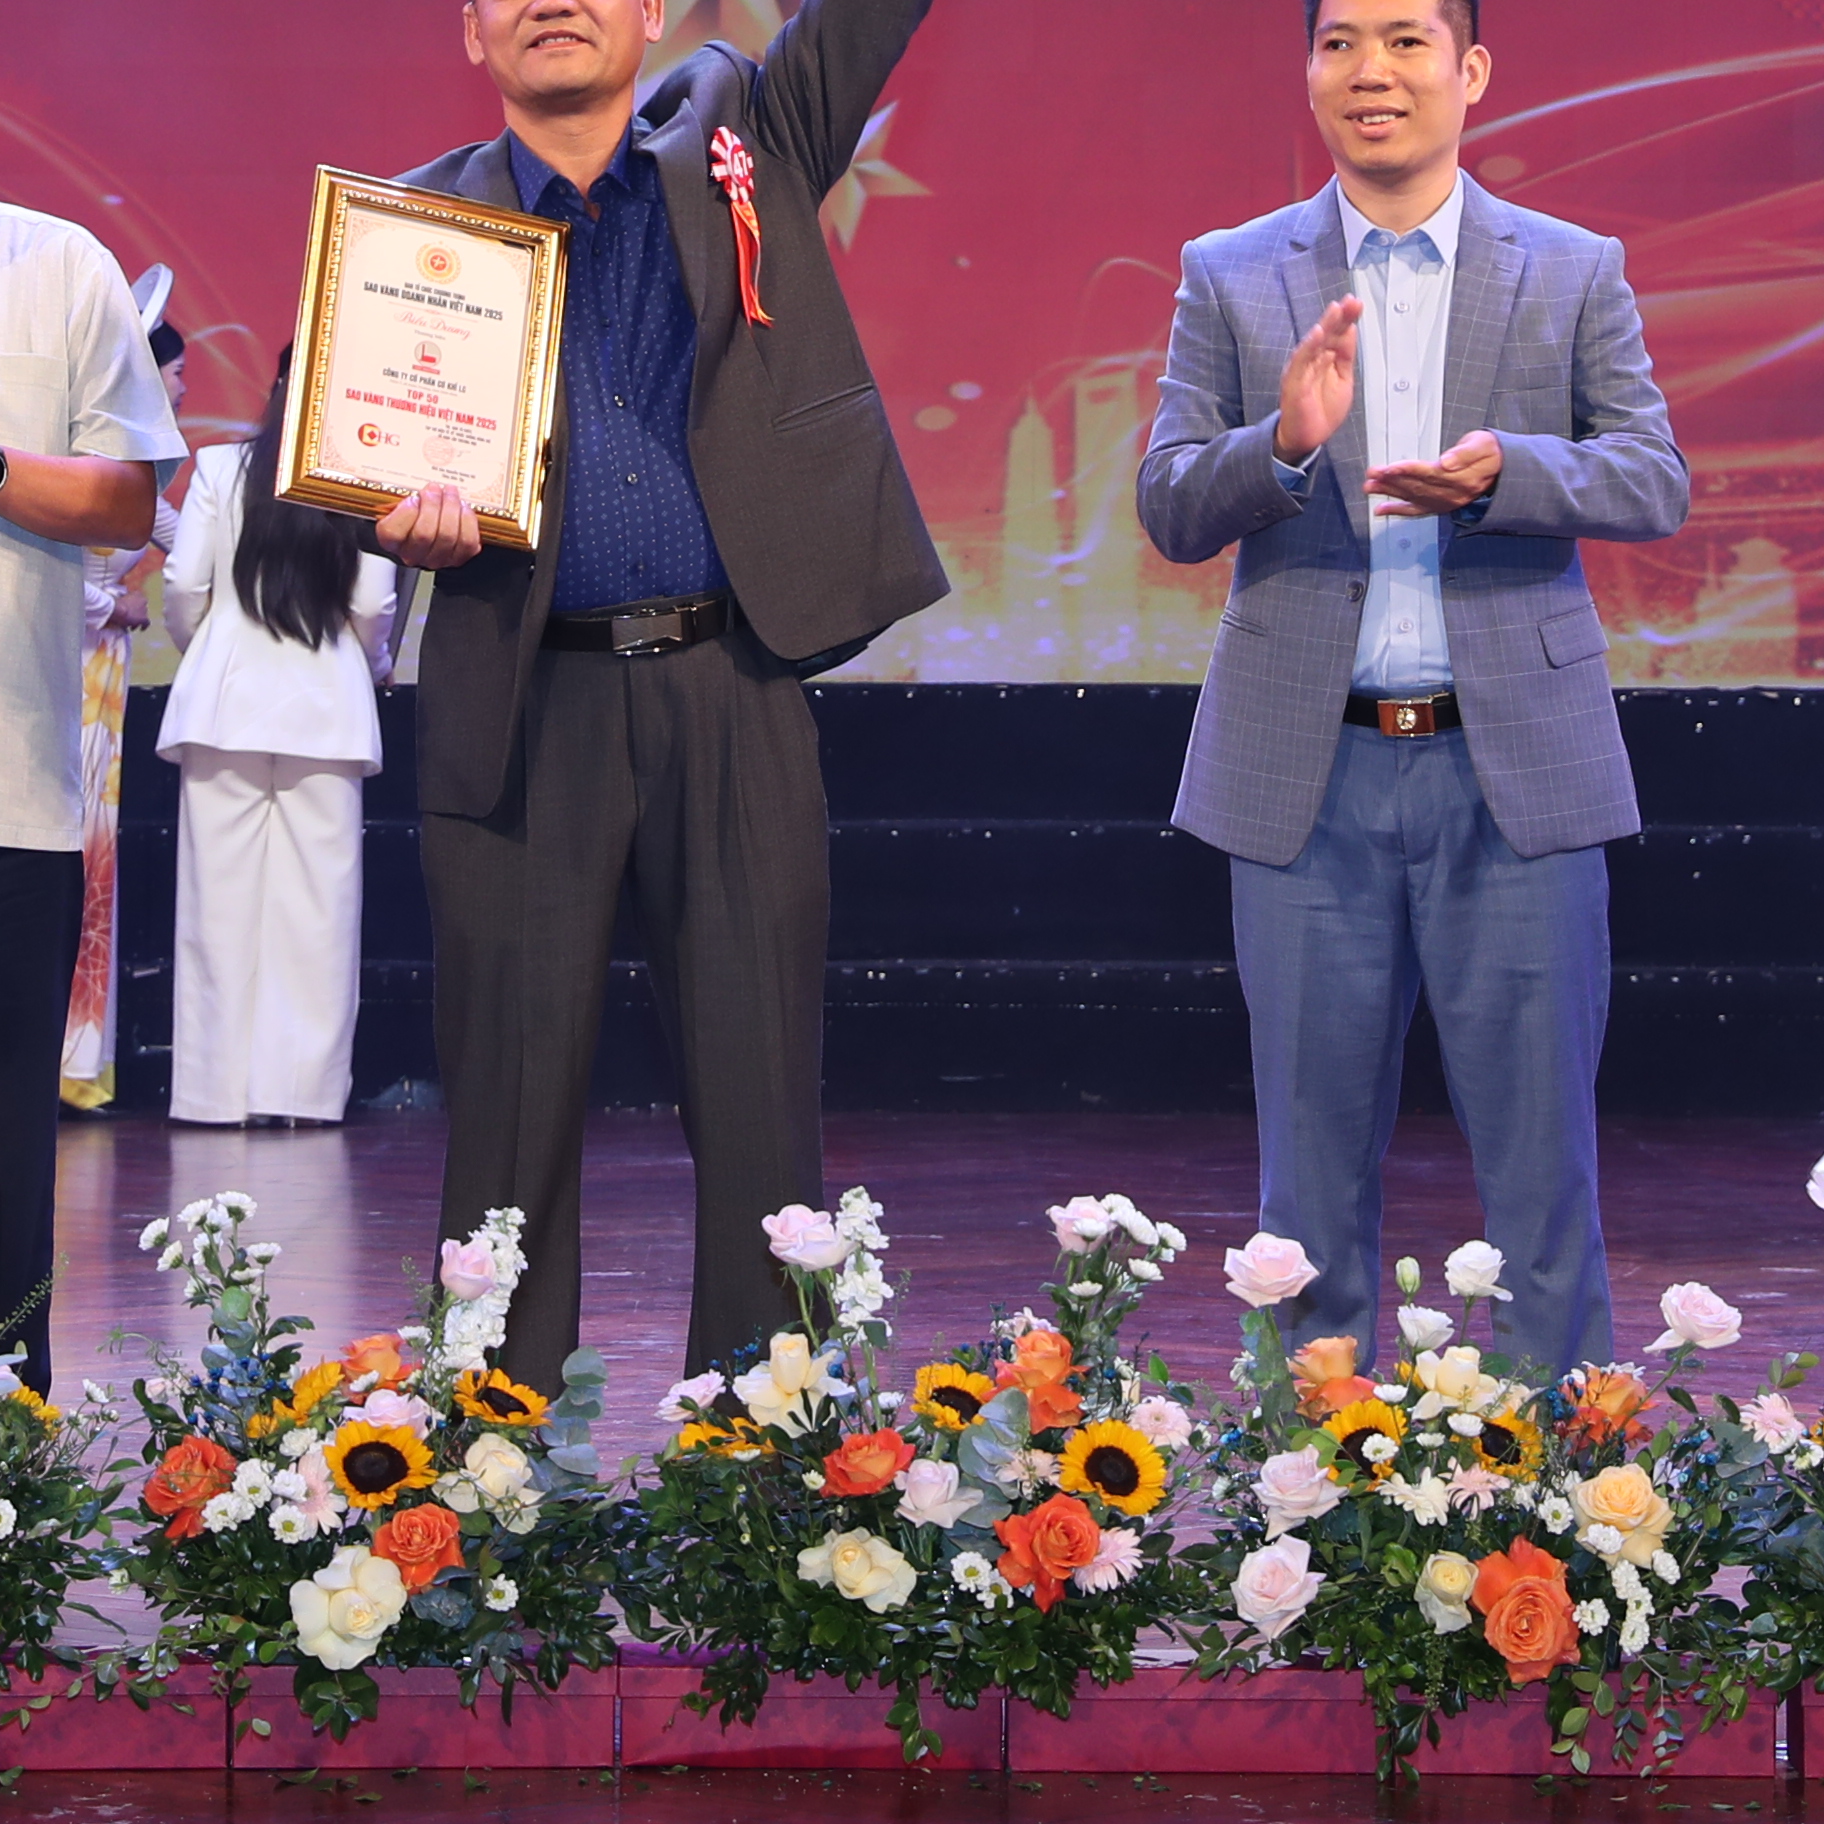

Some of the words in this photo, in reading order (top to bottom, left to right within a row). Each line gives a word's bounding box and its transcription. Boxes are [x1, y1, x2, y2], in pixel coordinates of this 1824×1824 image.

[733, 150, 749, 178] 47
[363, 281, 379, 293] SAO
[380, 284, 399, 298] VÀNG
[401, 289, 425, 303] DOANH
[427, 295, 447, 309] NHÂN
[465, 304, 483, 317] NAM
[484, 308, 503, 321] 2025
[401, 371, 408, 381] TY
[345, 388, 362, 401] SAO
[363, 390, 384, 406] VÀNG
[386, 396, 417, 414] THƯƠNG
[438, 407, 455, 423] VIỆT
[455, 412, 475, 425] NAM
[476, 416, 498, 431] 2025
[407, 388, 425, 401] TOP
[426, 393, 439, 405] 50
